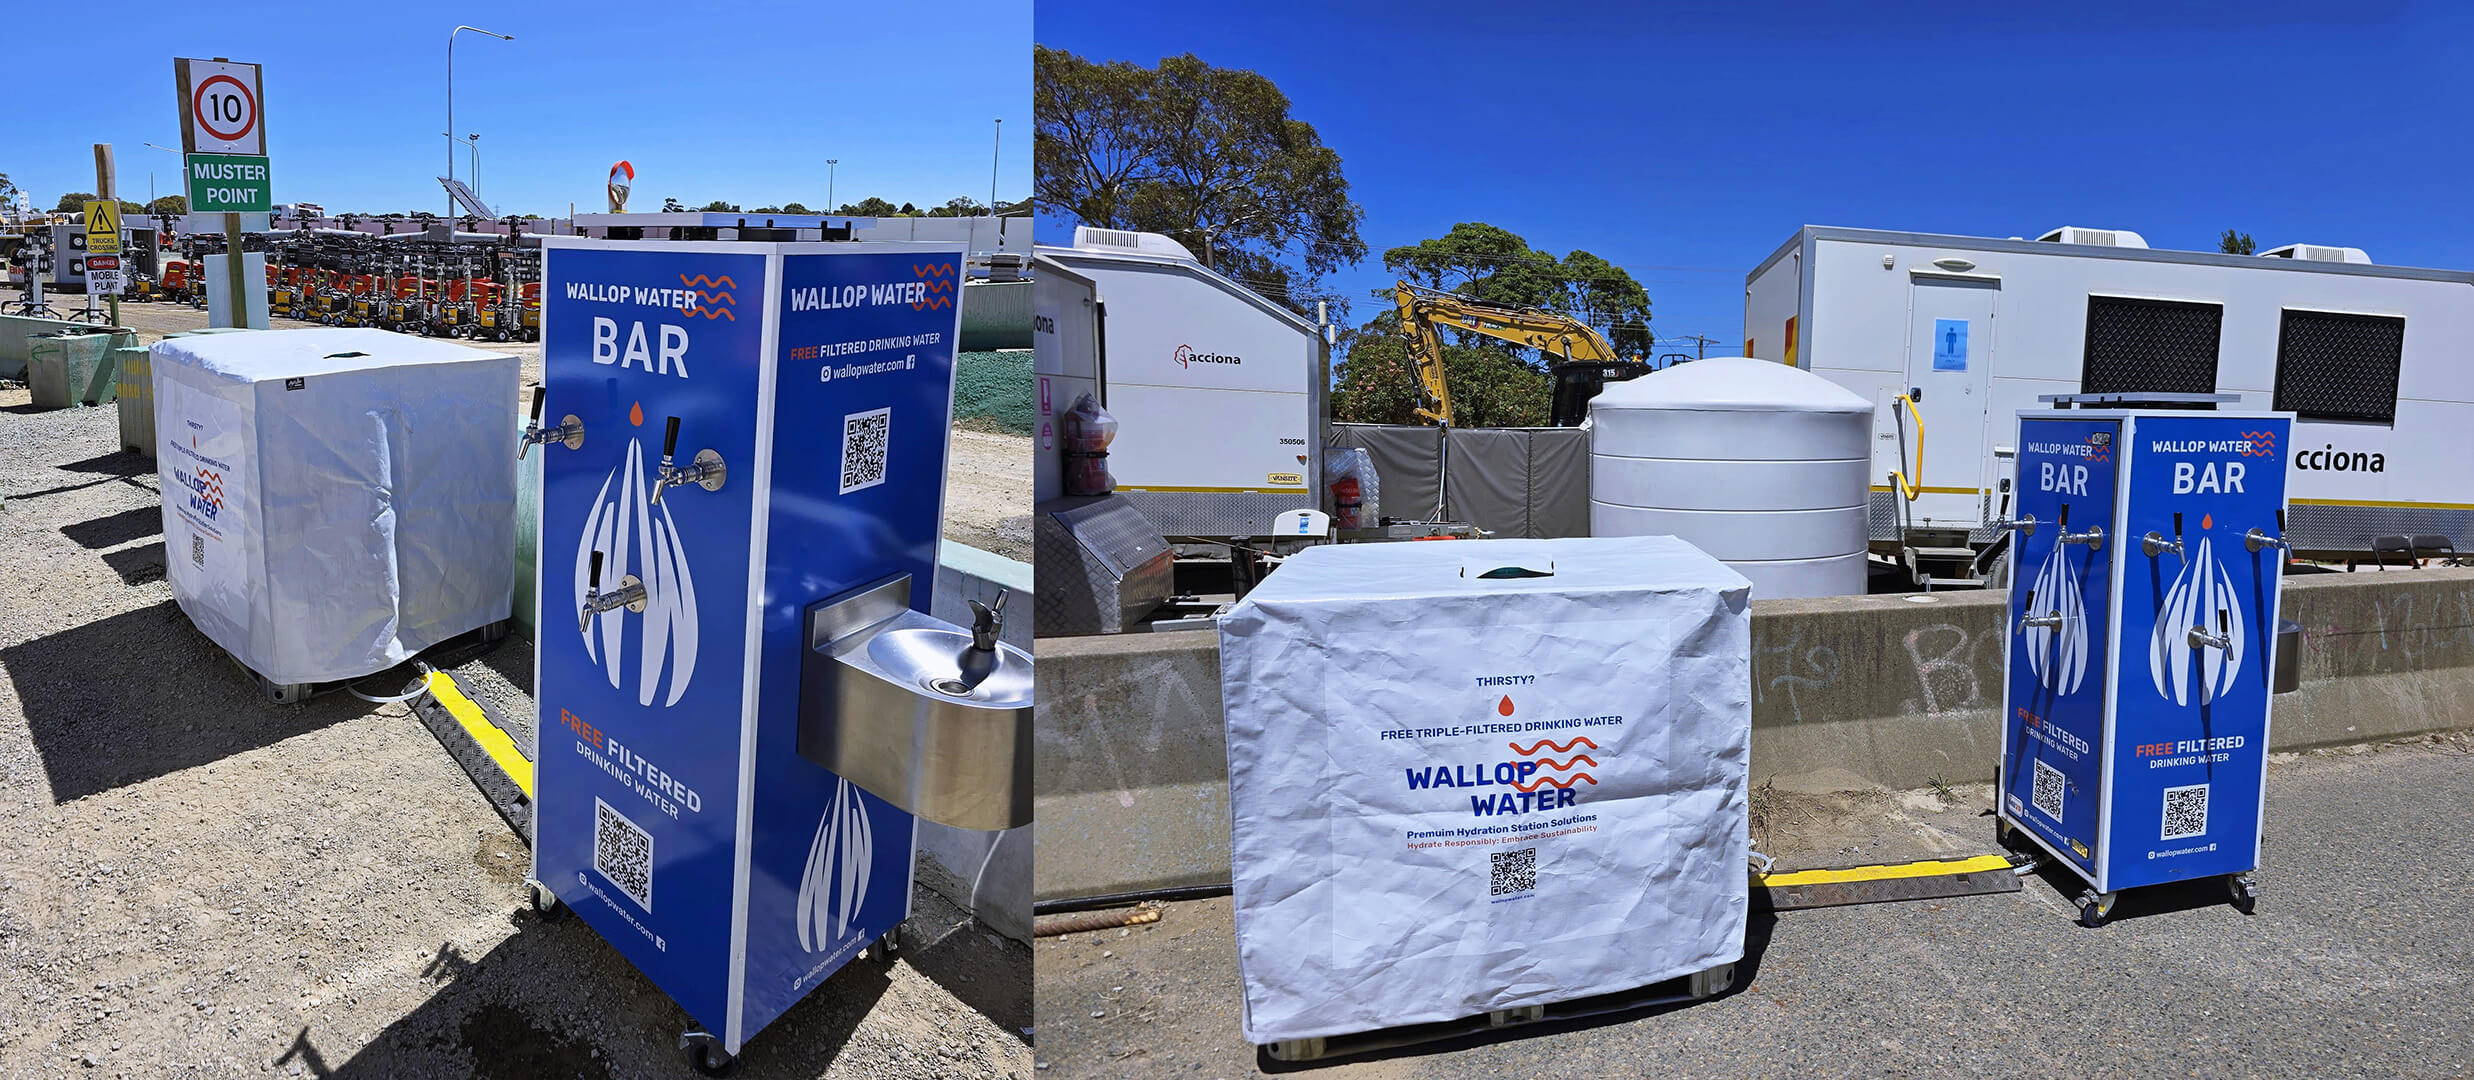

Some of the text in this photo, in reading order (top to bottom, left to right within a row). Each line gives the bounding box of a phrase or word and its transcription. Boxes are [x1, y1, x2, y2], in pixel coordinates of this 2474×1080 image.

[210, 94, 242, 123] 10
[194, 163, 266, 181] MUSTER
[207, 188, 258, 204] POINT
[91, 271, 119, 280] MOBILE
[94, 281, 118, 291] PLANT
[566, 282, 697, 310] WALLOP WATER
[791, 282, 926, 312] WALLOP WATER
[593, 316, 689, 379] BAR
[790, 333, 940, 361] FREE FILTERED DRINKING WATER
[1189, 353, 1241, 365] acciona
[833, 359, 904, 379] wallopwater.com
[1602, 369, 1616, 377] 315
[1280, 438, 1305, 446] 350506
[2028, 442, 2093, 457] WALLOP WATER
[2152, 440, 2252, 453] WALLOP WATER
[2295, 444, 2385, 474] cciona
[173, 466, 207, 494] WALLOP
[2041, 462, 2088, 496] BAR
[2173, 462, 2246, 494] BAR
[190, 493, 217, 521] WATER
[1476, 675, 1535, 687] THIRSTY?
[1381, 715, 1623, 740] FREE TRIPLE-FILTERED DRINKING WATER
[2017, 707, 2089, 754] FREE FILTERED
[2025, 726, 2079, 762] DRINKING WATER
[2136, 735, 2245, 758] FREE FILTERED
[561, 708, 701, 813] FREE FILTERED
[2150, 752, 2230, 769] DRINKING WATER
[576, 741, 679, 821] DRINKING WATER
[1406, 761, 1537, 790] WALLOP
[1471, 787, 1576, 816] WATER
[1407, 813, 1597, 839] Premuim Hydration Station Solutions
[1407, 824, 1598, 850] Hydrate Responsibly: Embrace Sustainability
[2156, 845, 2208, 858] wallopwater.com
[588, 881, 654, 942] wallopwater.com
[802, 937, 857, 983] wallopwater.com
